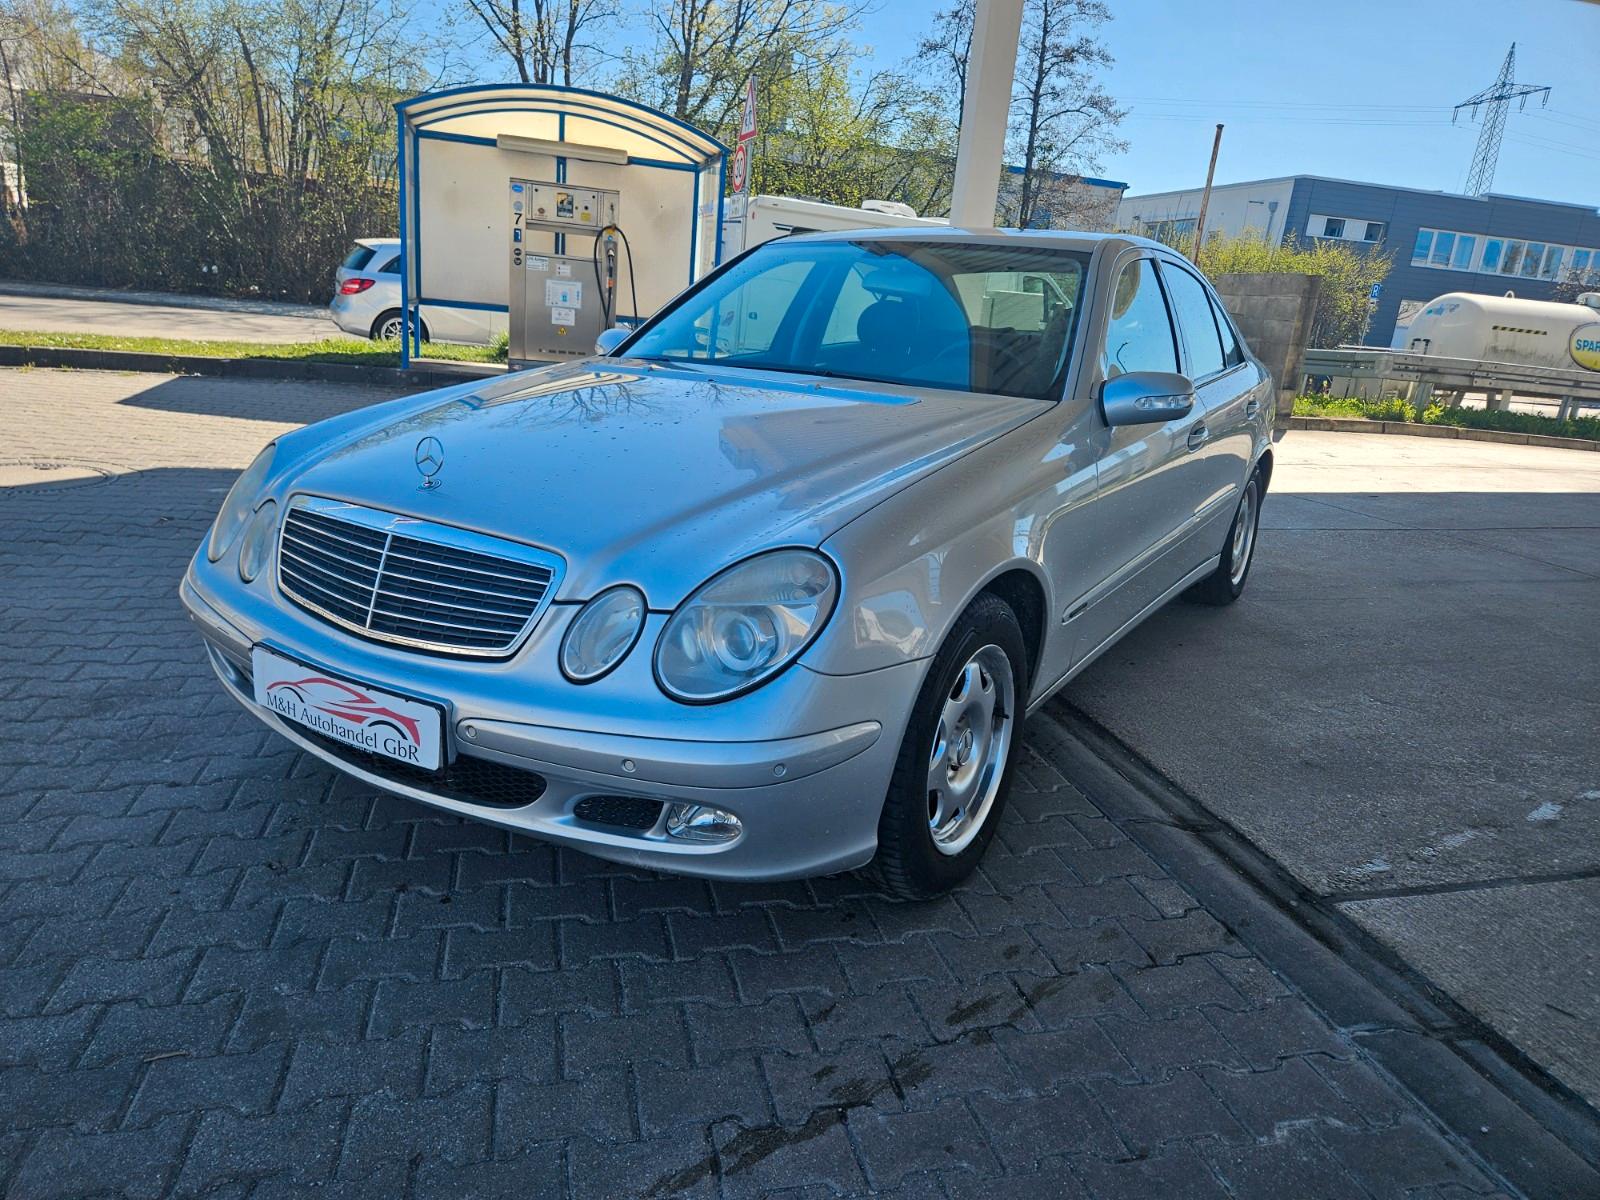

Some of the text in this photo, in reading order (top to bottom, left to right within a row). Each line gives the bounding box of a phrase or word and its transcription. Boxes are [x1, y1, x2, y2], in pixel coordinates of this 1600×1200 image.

[514, 212, 522, 225] 7
[266, 691, 297, 718] M&H
[300, 707, 378, 749] Autohandel
[383, 737, 420, 762] GbR
